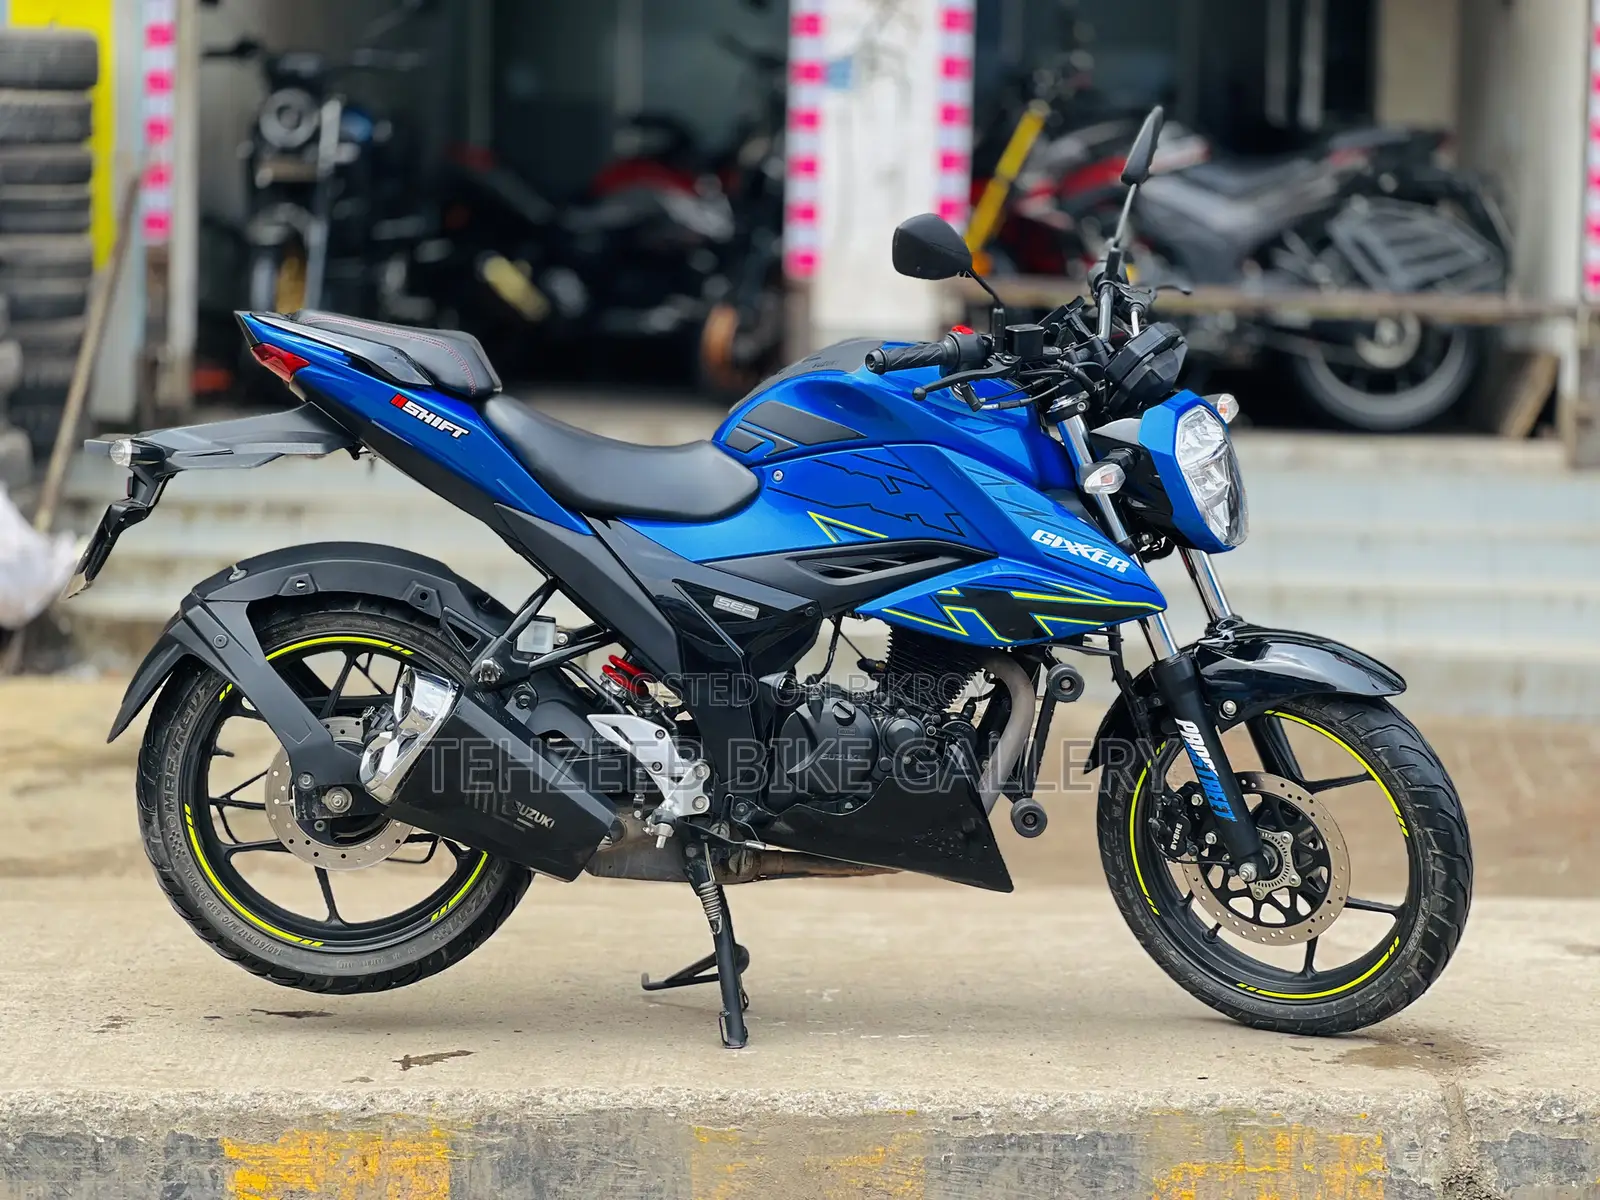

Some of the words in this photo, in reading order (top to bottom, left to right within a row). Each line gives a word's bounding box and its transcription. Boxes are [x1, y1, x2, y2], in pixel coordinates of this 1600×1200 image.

[402, 400, 469, 438] SHIFT
[1031, 529, 1130, 573] GIXXER
[717, 598, 756, 612] SEP
[1170, 822, 1183, 851] BYBRE
